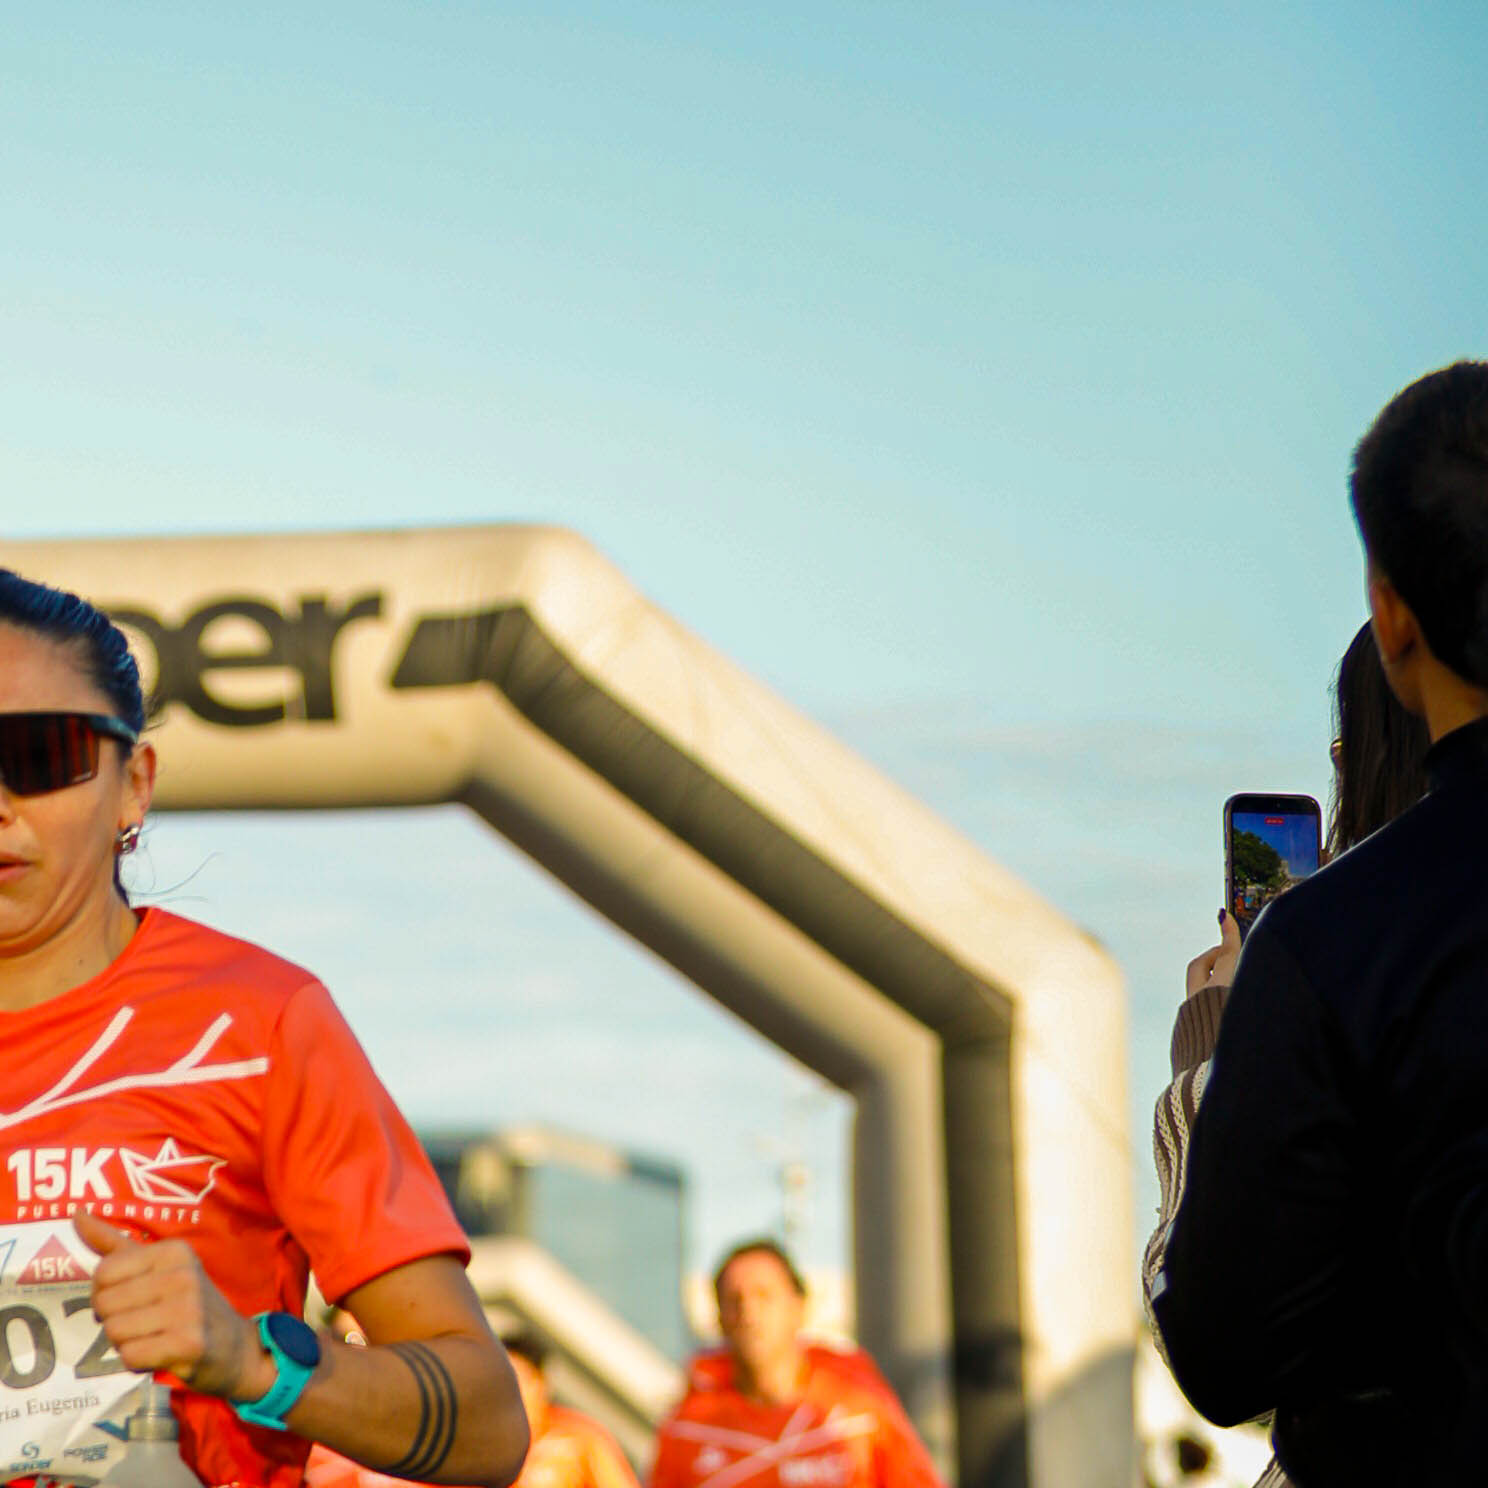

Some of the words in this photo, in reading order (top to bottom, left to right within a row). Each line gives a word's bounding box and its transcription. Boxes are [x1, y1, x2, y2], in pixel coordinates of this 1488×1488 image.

[7, 1147, 116, 1201] 15K
[17, 1202, 114, 1219] PUERTO
[125, 1204, 201, 1224] NORTE
[30, 1256, 78, 1280] 15K
